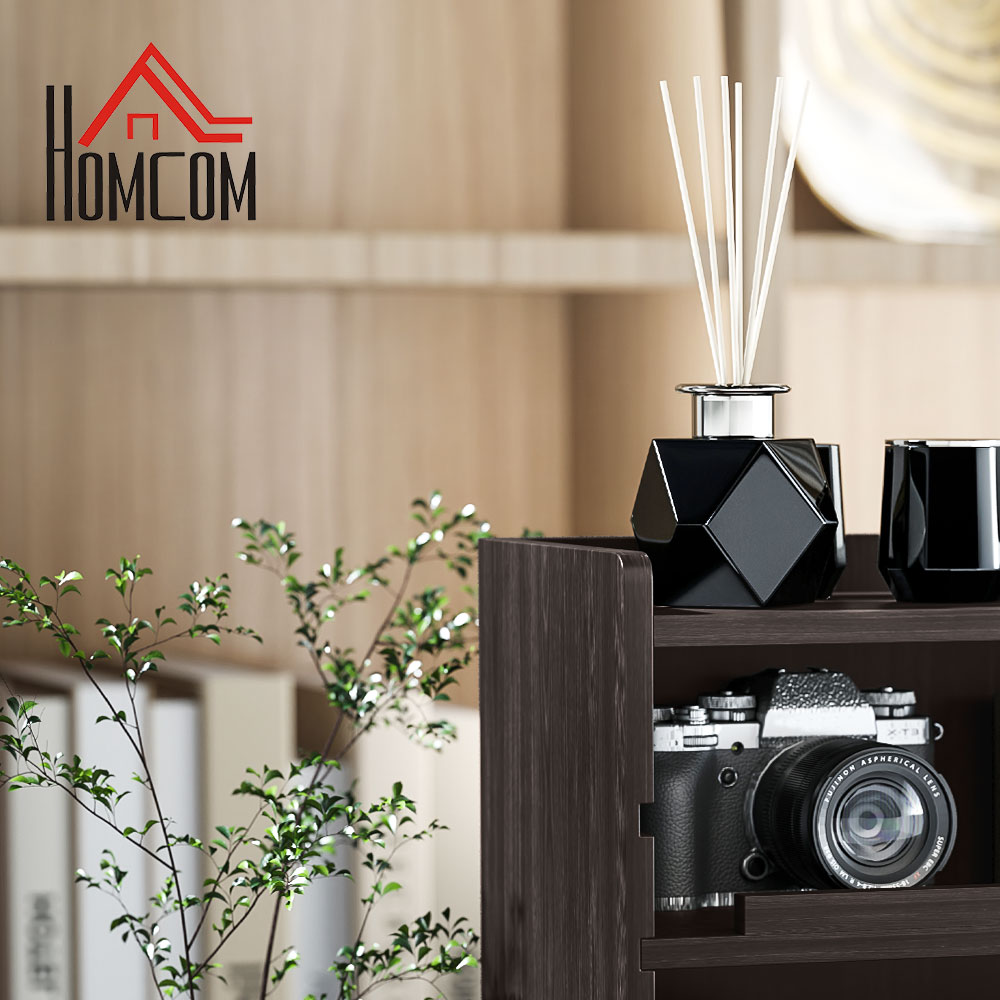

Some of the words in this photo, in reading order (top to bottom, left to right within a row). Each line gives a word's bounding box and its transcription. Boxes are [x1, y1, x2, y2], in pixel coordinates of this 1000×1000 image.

[824, 764, 856, 803] FUJINON
[860, 755, 921, 774] ASPHERICAL
[923, 774, 941, 798] LENS
[931, 835, 945, 858] SUPER
